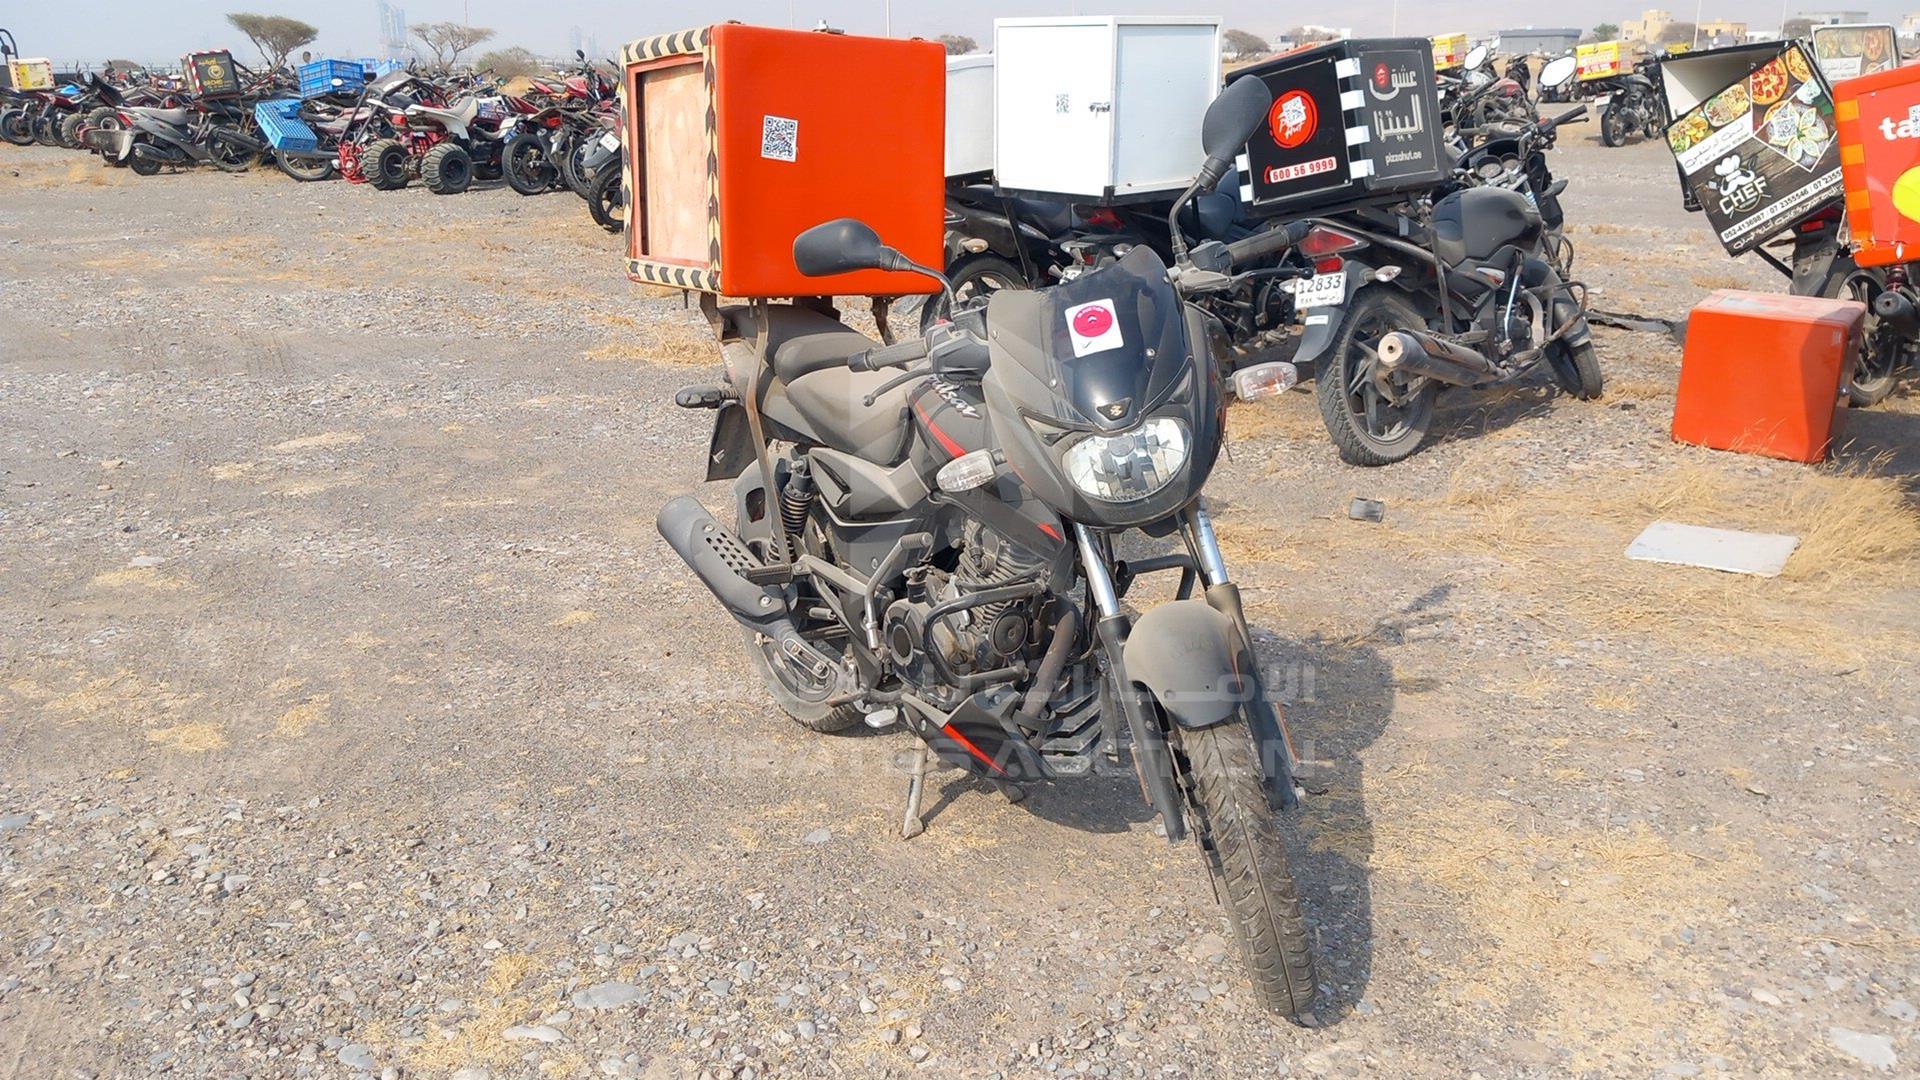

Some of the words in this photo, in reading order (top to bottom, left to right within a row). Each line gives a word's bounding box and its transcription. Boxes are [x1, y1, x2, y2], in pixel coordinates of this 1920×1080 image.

[1368, 64, 1418, 101] عشق
[1373, 93, 1424, 143] البيتزا
[1272, 169, 1291, 182] 600
[1293, 164, 1306, 176] 56
[1309, 159, 1335, 173] 9999
[1719, 176, 1768, 216] CHEF
[1769, 205, 1779, 215] 07
[1812, 180, 1822, 190] 07
[1299, 275, 1341, 294] 12833
